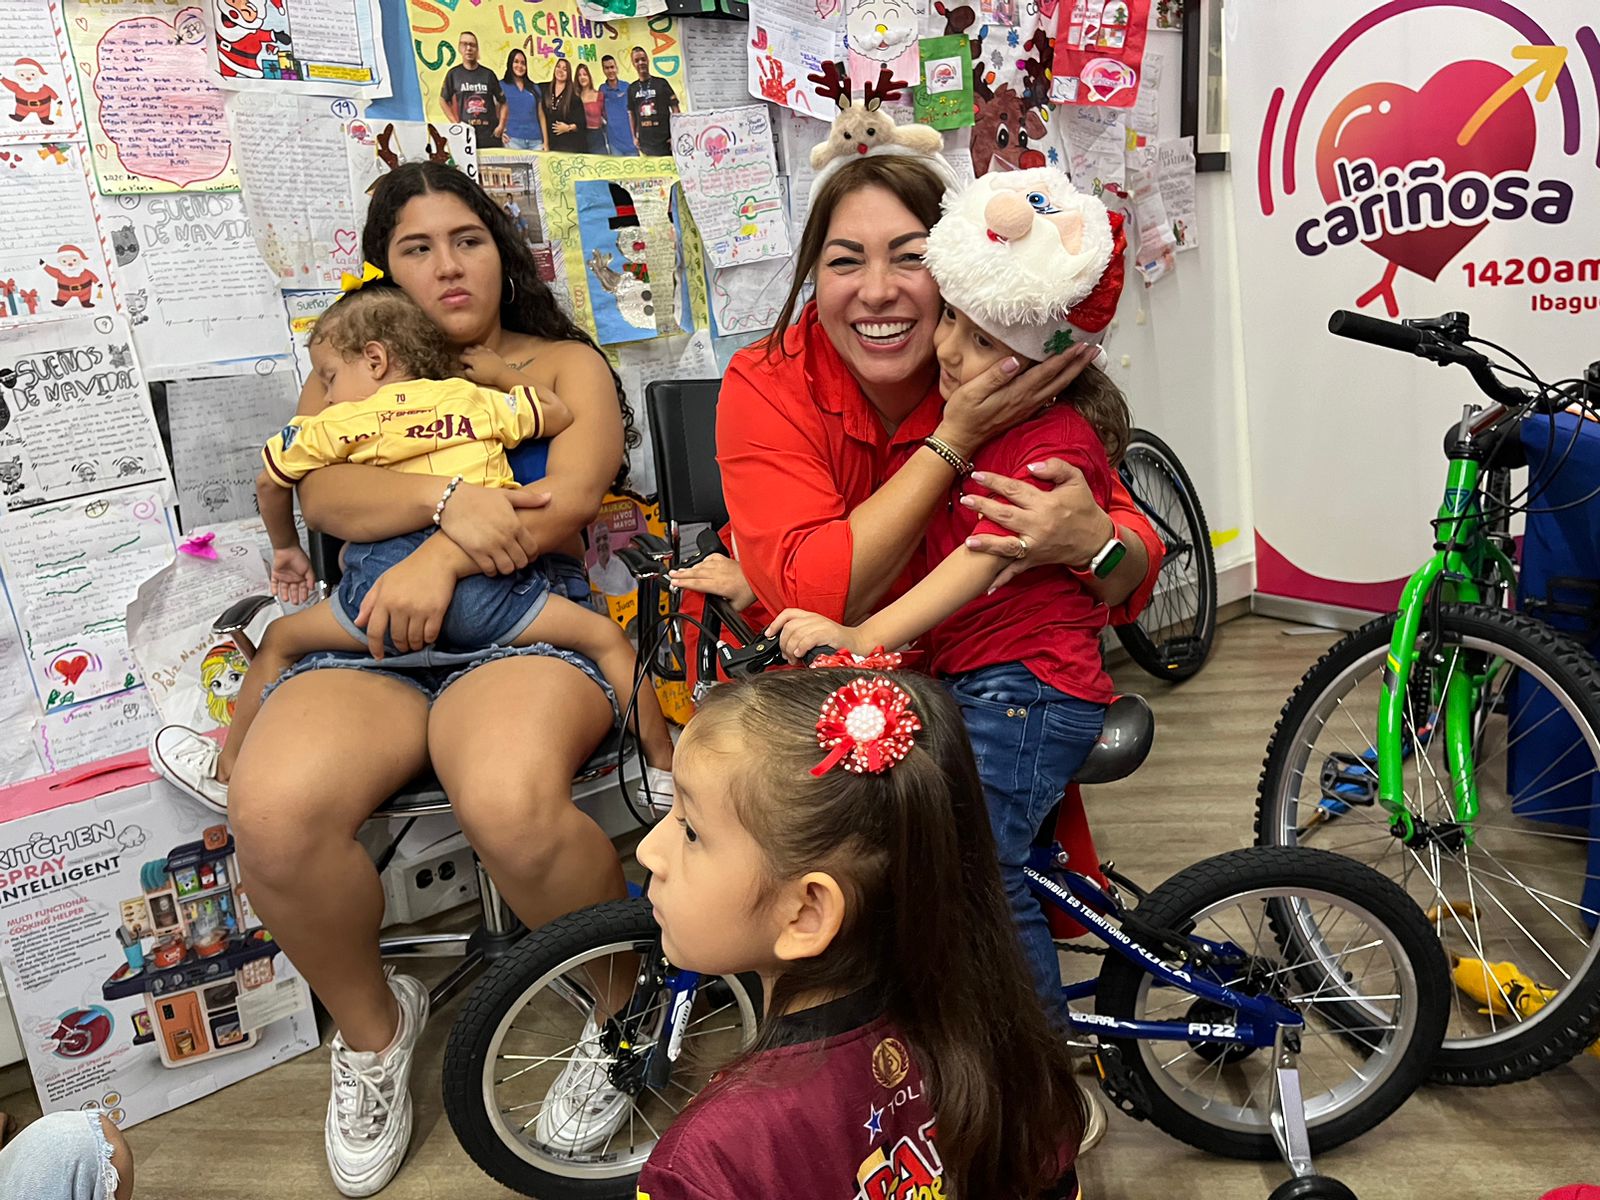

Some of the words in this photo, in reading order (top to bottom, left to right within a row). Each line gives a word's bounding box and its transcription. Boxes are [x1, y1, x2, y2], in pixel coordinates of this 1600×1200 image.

[498, 4, 527, 34] LA
[523, 34, 573, 59] 1420
[578, 43, 598, 63] AM
[647, 15, 681, 77] DAD
[335, 101, 351, 115] 19
[1337, 162, 1375, 197] la
[1295, 164, 1574, 256] cariñosa
[144, 224, 170, 248] DE
[175, 220, 255, 243] NAVIDA
[1462, 257, 1600, 287] 1420am
[1531, 295, 1600, 314] Ibagu
[12, 386, 41, 411] DE
[395, 393, 406, 403] 70
[404, 414, 478, 440] ROJA
[600, 501, 633, 513] AURICIO
[613, 518, 636, 529] MAYOR
[615, 599, 635, 612] Juan
[180, 634, 225, 663] Navida
[0, 856, 120, 904] NTELLIGENT
[7, 914, 33, 927] MULTI
[35, 897, 89, 918] FUNCTIONAL
[1023, 866, 1069, 900] COLOMBIA
[1067, 895, 1081, 908] ES
[1079, 904, 1131, 945] TERRITORIO
[9, 917, 51, 936] COOKING
[52, 907, 85, 922] HELPER
